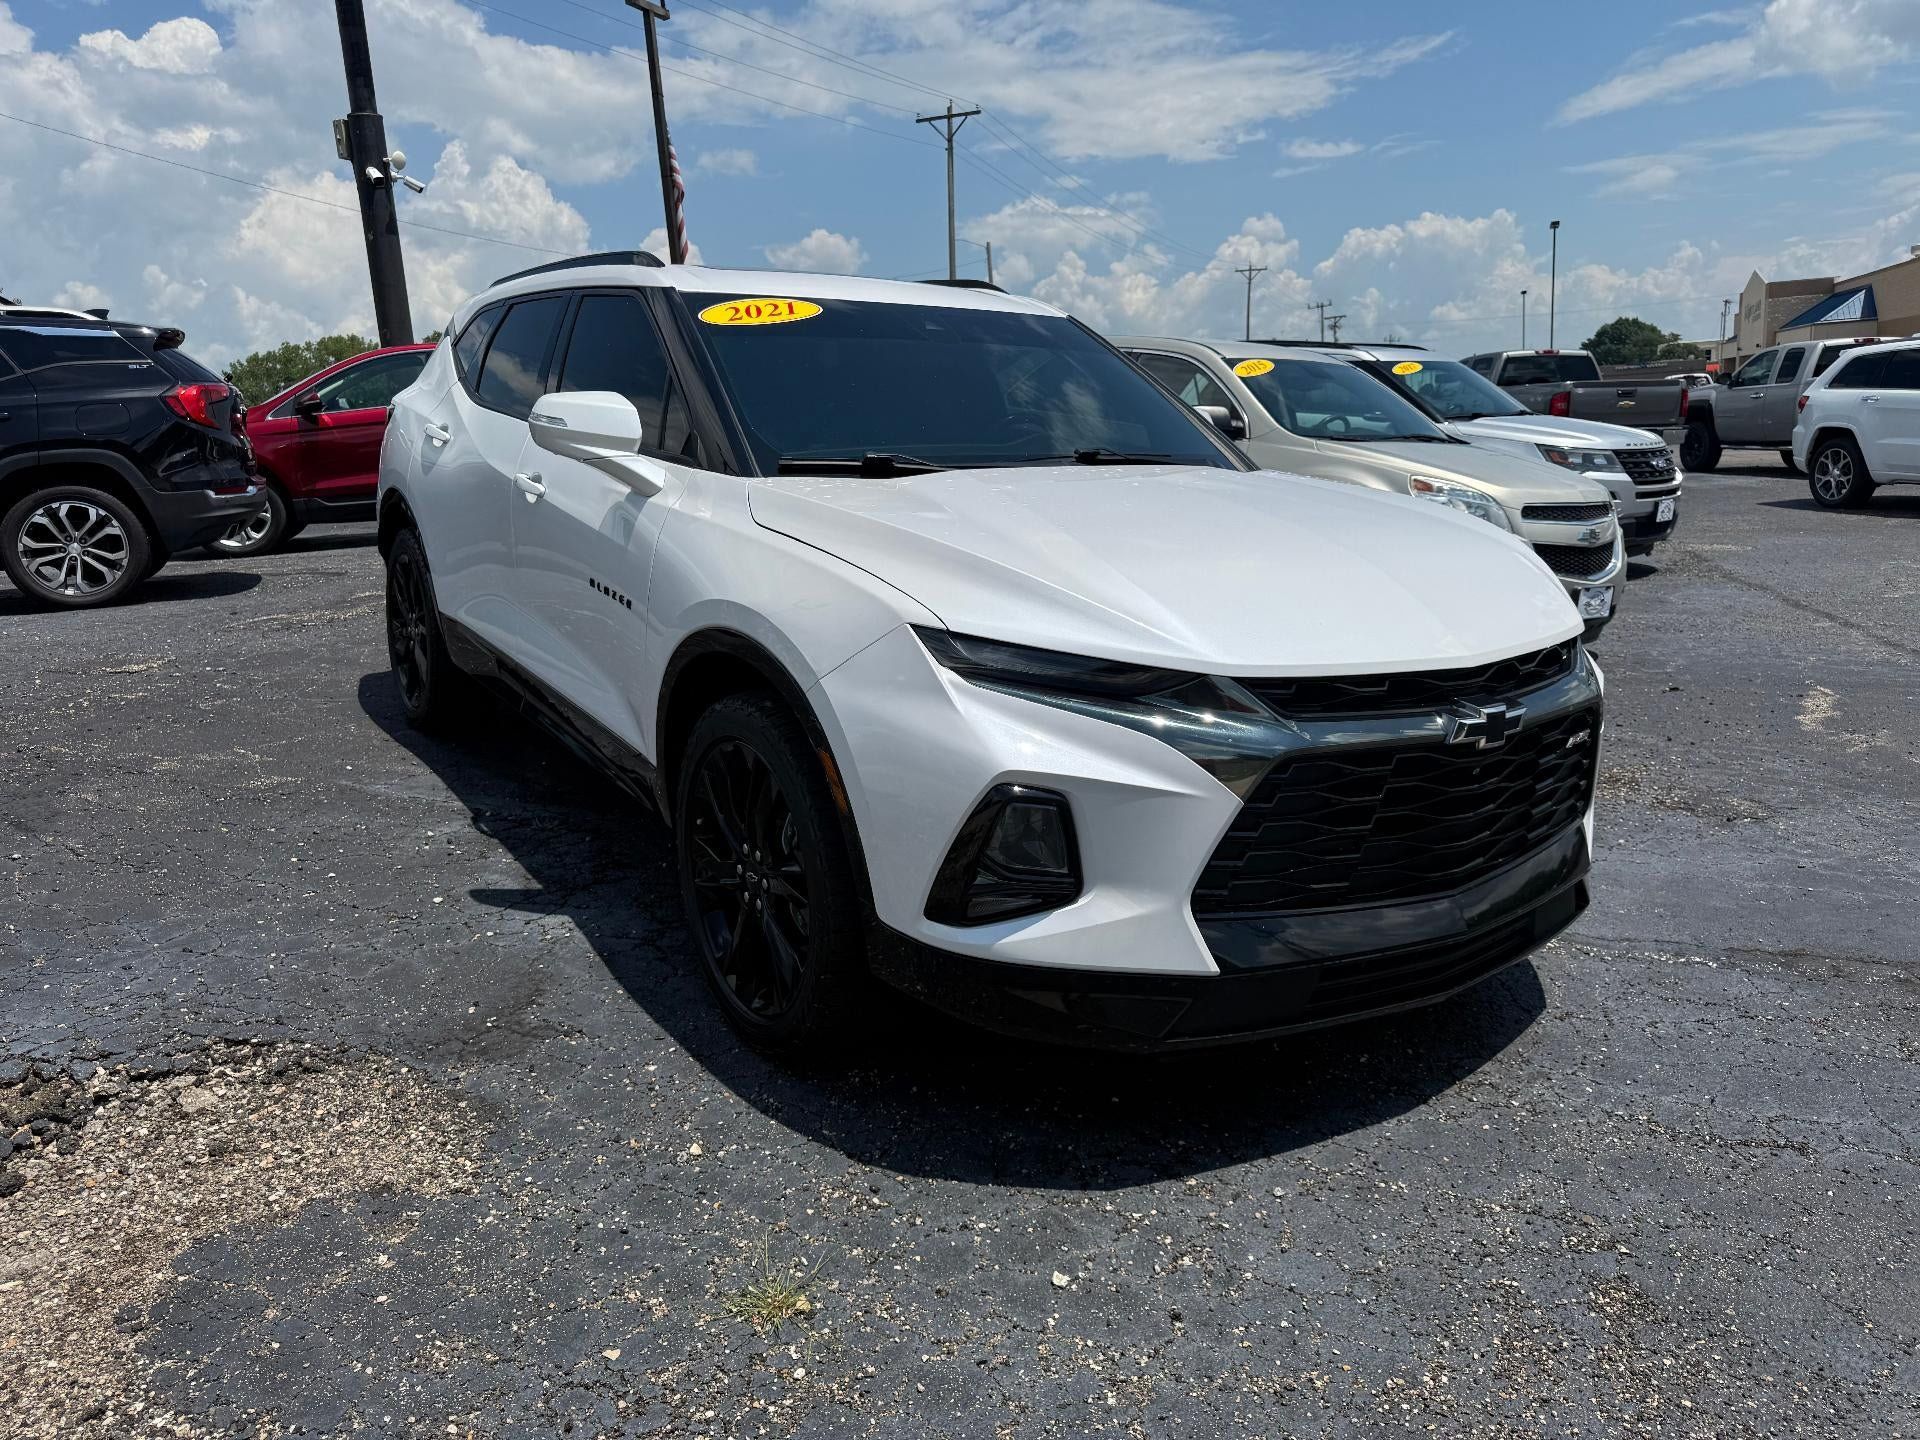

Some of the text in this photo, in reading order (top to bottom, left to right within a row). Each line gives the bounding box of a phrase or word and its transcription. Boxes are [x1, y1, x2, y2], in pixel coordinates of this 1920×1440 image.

[725, 302, 799, 321] 2021
[1240, 361, 1268, 375] 2015
[589, 577, 632, 610] BLAZER
